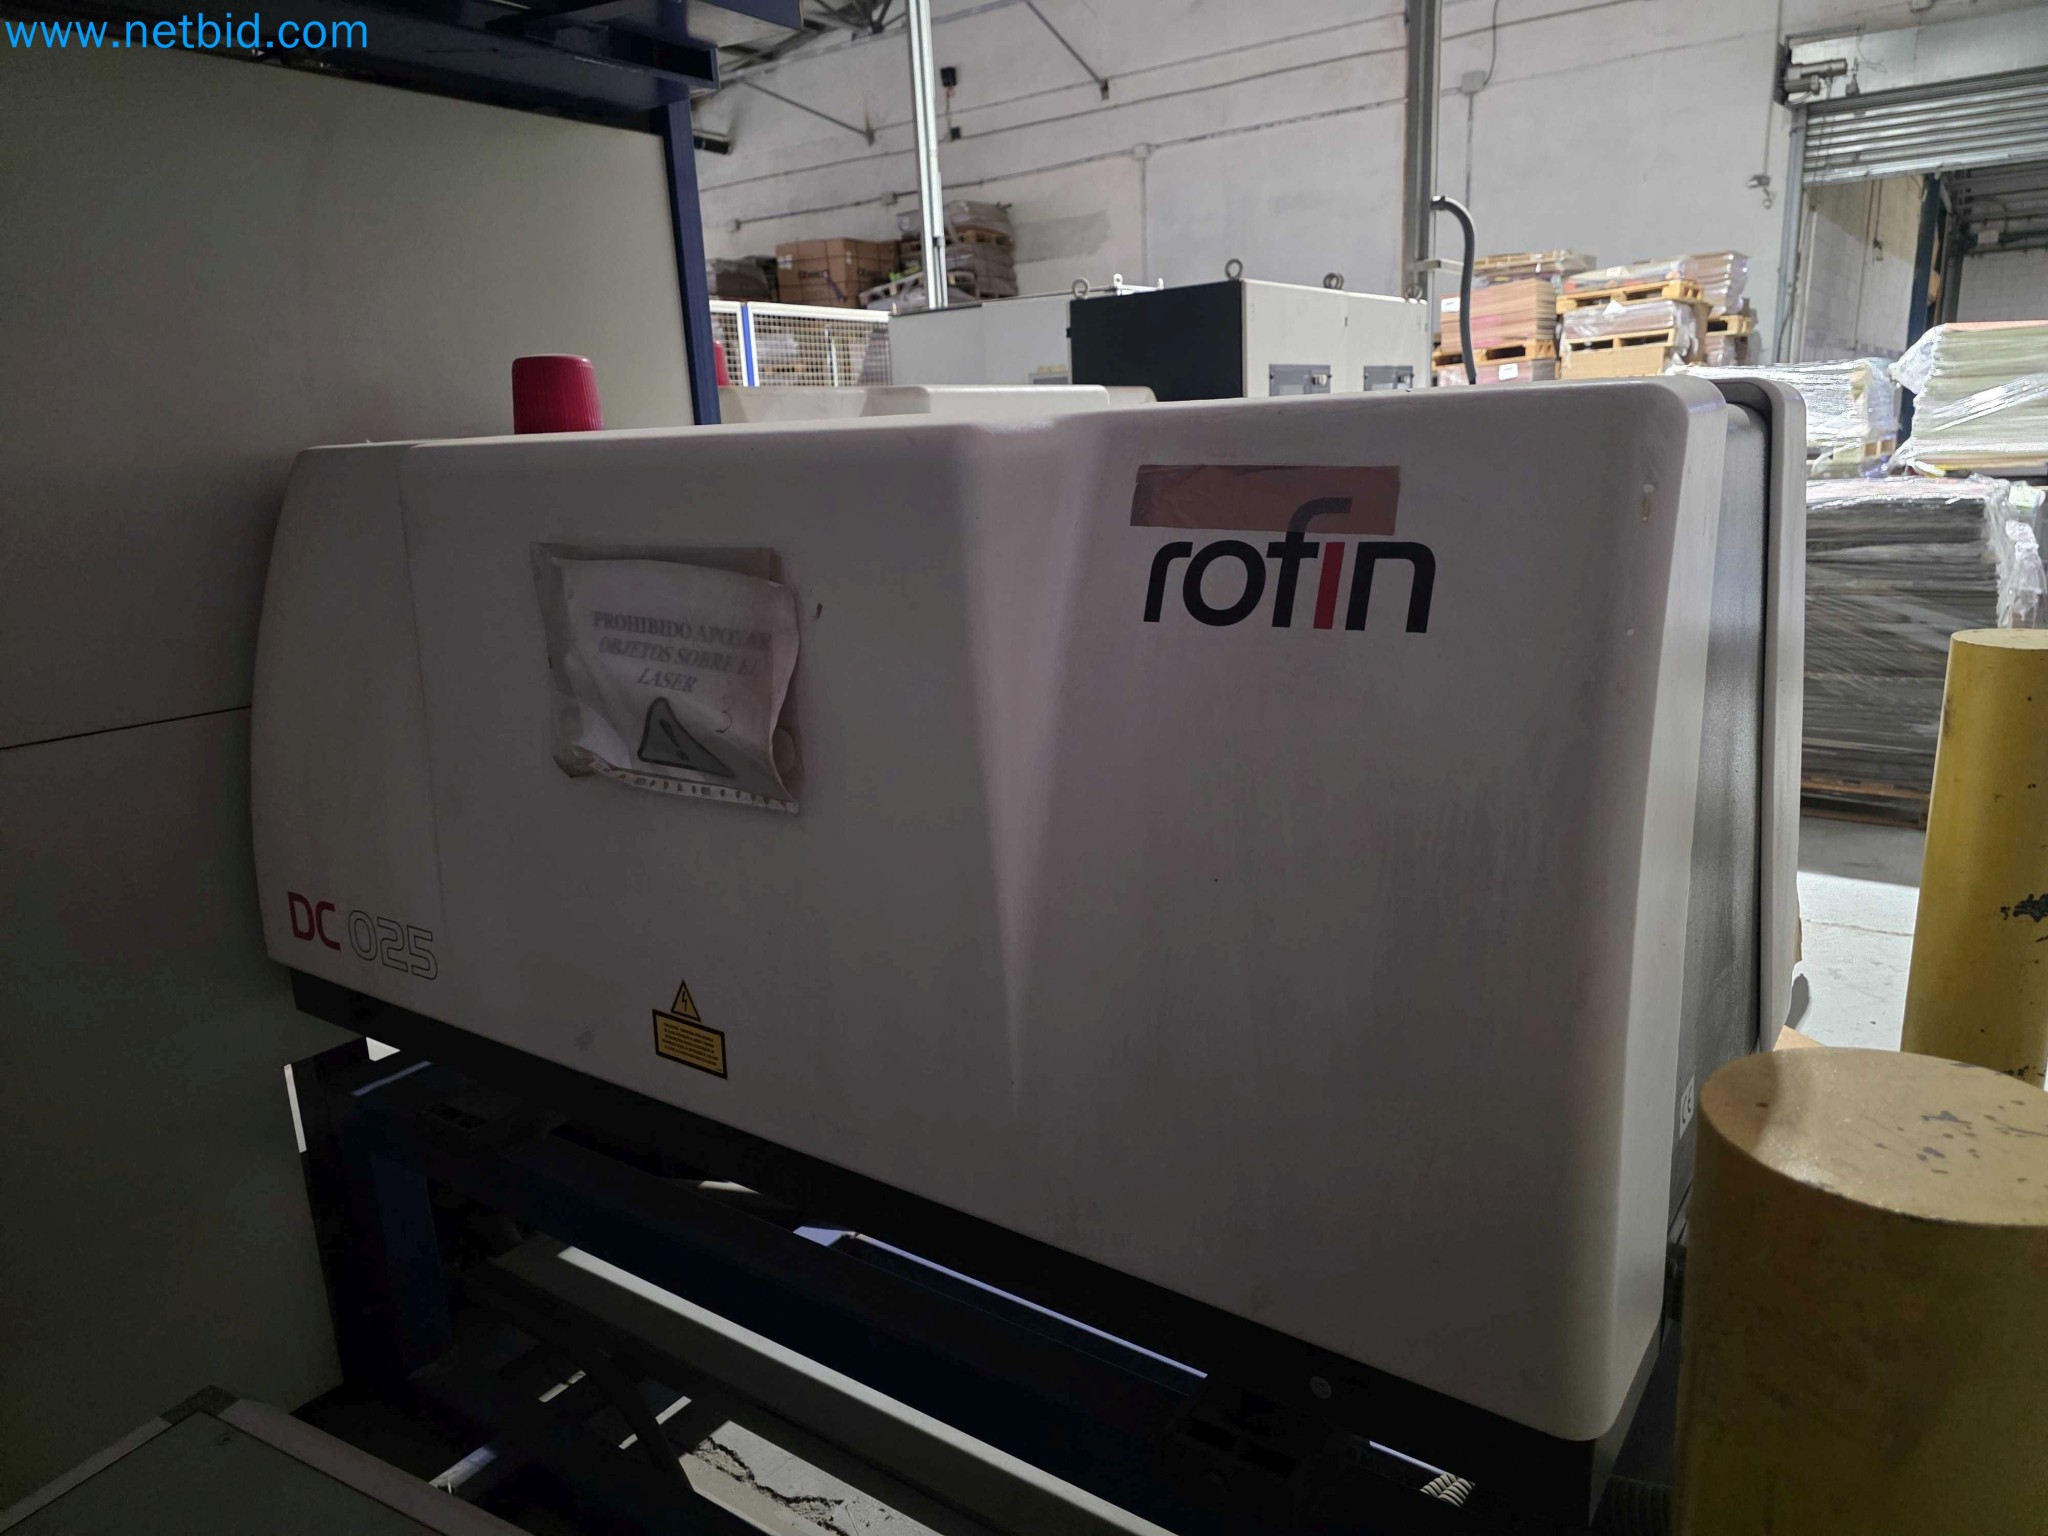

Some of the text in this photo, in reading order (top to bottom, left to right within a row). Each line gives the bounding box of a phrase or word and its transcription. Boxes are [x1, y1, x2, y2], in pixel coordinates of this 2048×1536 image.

[1143, 497, 1437, 633] rofin
[592, 611, 692, 639] PROHIBIDO
[599, 636, 672, 663] OBJETOS
[674, 647, 736, 674] SOBRE
[637, 668, 698, 693] LASER
[287, 891, 438, 980] DC 025
